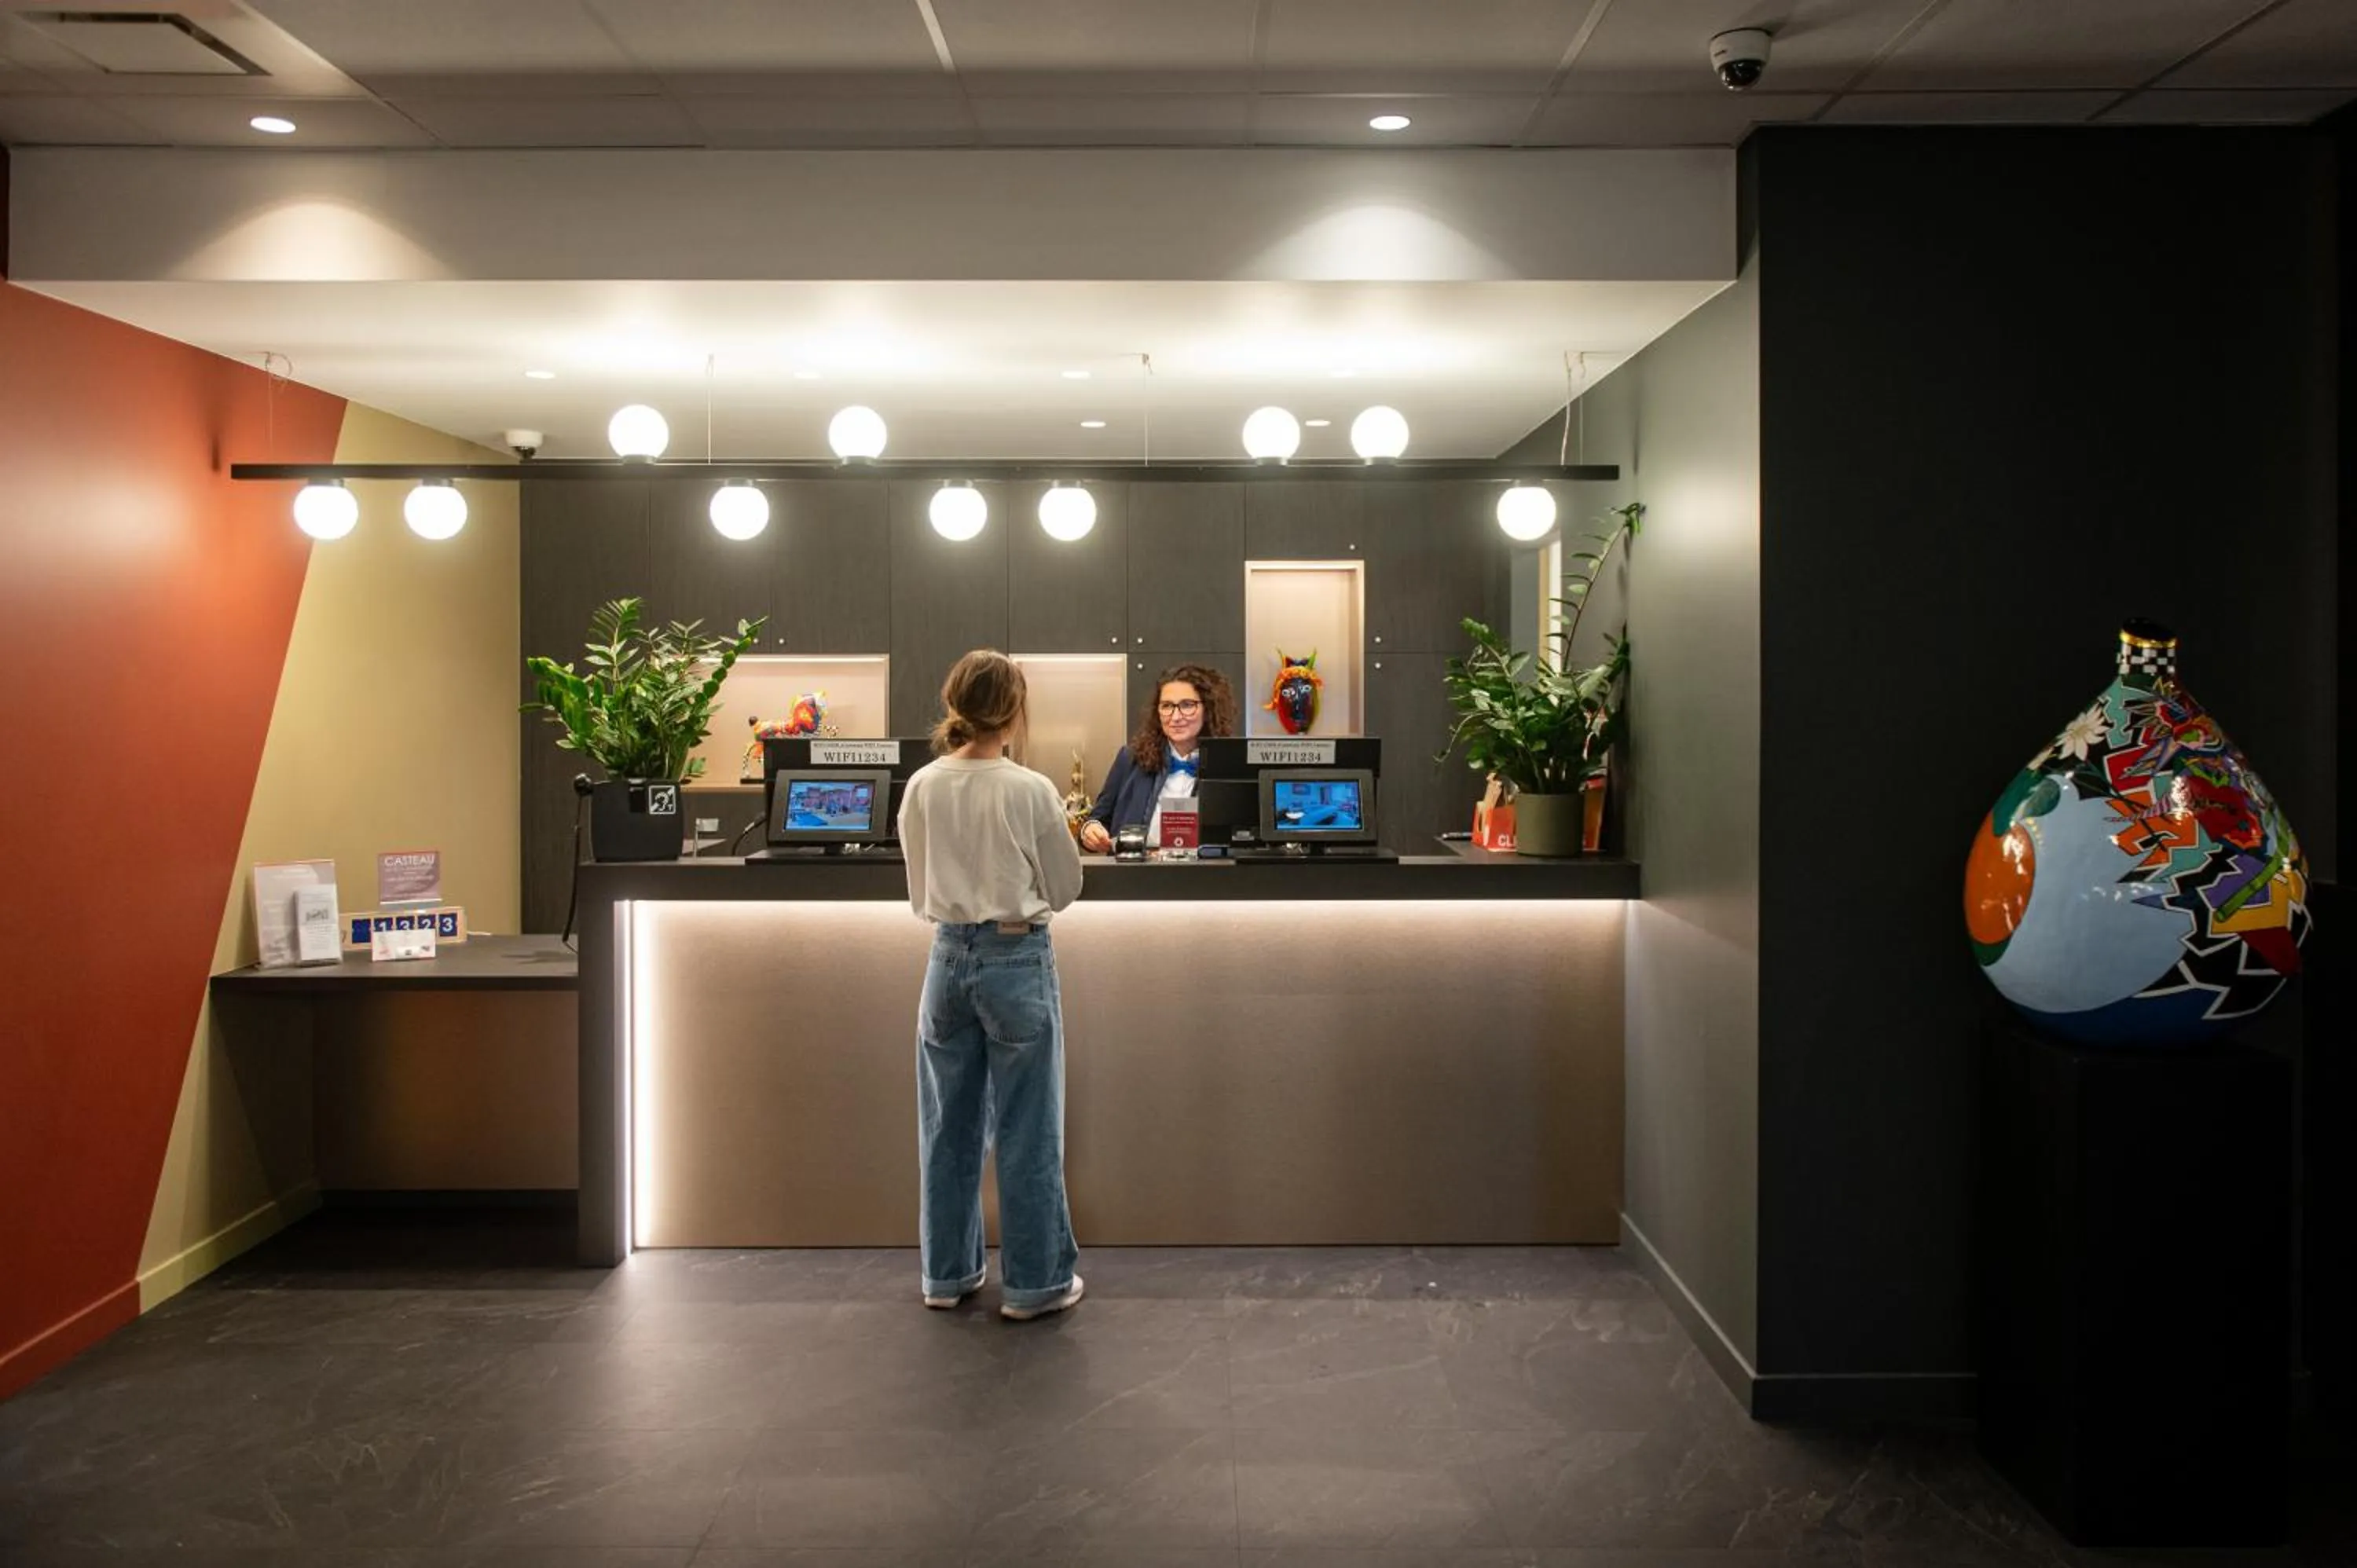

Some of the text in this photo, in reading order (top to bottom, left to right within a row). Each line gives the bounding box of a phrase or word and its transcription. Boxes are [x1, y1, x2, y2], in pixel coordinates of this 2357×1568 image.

[823, 752, 885, 762] WIFI1234
[1260, 752, 1321, 762] WIFI1234
[384, 854, 435, 866] CASTEAU
